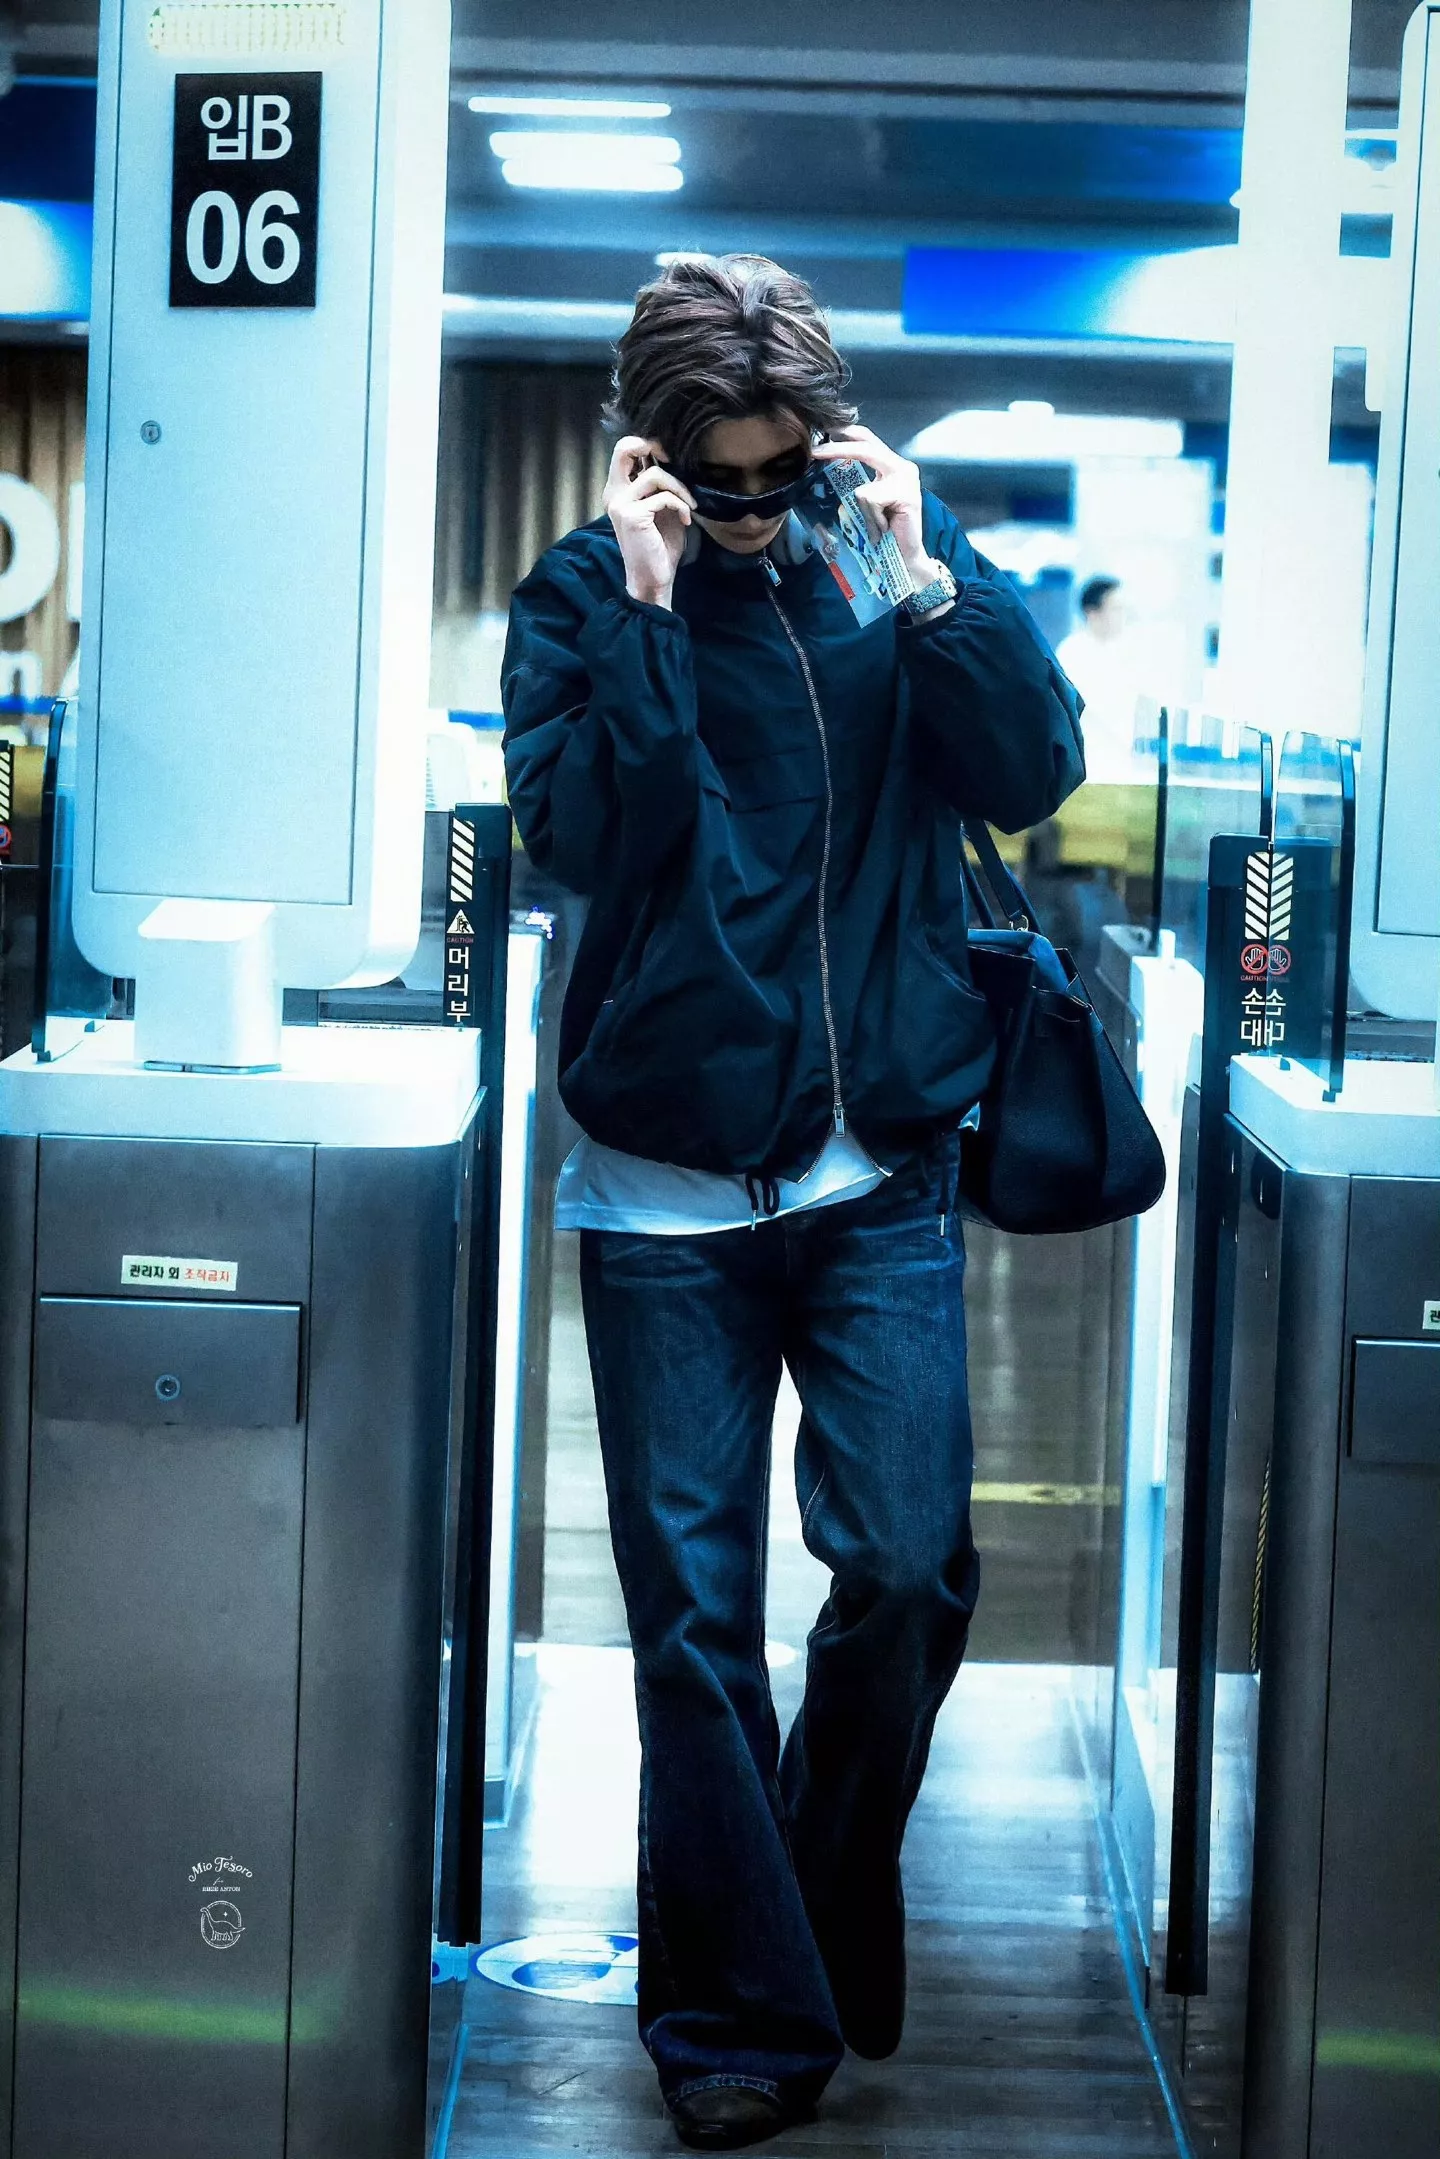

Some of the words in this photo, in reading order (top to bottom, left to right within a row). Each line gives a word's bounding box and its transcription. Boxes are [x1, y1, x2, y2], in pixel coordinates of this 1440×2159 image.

[200, 94, 293, 161] 입B
[186, 189, 301, 285] 06
[130, 1264, 164, 1279] 관리자
[168, 1266, 180, 1280] 외
[184, 1268, 229, 1282] 조작금지
